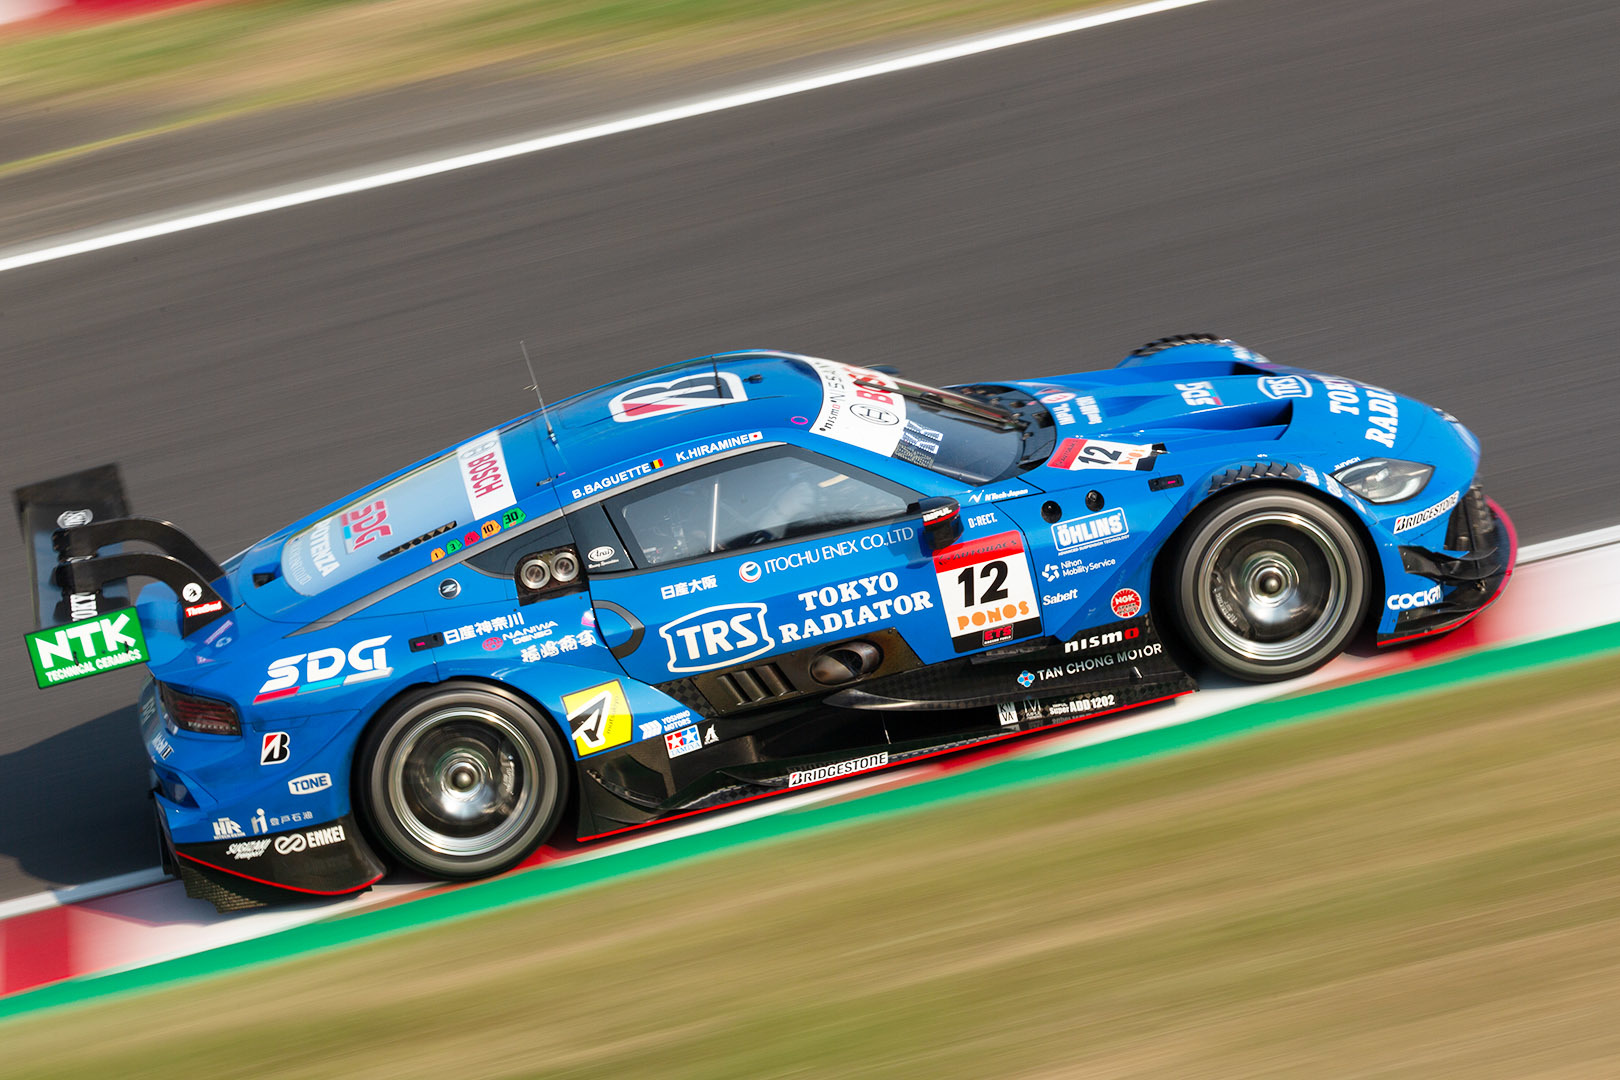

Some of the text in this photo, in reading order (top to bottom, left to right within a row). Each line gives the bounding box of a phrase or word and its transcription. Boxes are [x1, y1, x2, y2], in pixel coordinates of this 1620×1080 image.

[1365, 388, 1398, 448] RADI
[676, 434, 749, 462] K.HIRAMINE
[1078, 446, 1122, 465] 12
[467, 452, 503, 498] BOSCH
[572, 463, 651, 499] B.BAGUETTE
[350, 500, 392, 550] SDG
[504, 511, 519, 524] 30
[1396, 491, 1459, 532] BRIDGESTONE
[483, 524, 494, 534] 10
[1056, 513, 1123, 547] ÖHLINS
[449, 543, 457, 551] 3
[764, 550, 820, 574] ITOCHU
[821, 540, 859, 560] ENEX
[952, 540, 1017, 561] AUTOBACS
[1061, 558, 1082, 569] Nihon
[1089, 558, 1116, 571] Service
[660, 575, 718, 600] 日産大阪
[797, 572, 898, 611] TOKYO
[957, 560, 1008, 608] 12
[1042, 588, 1079, 606] Sabelt
[70, 592, 98, 621] OKY
[778, 590, 933, 644] RADIATOR
[957, 600, 1029, 631] PONOS
[35, 613, 136, 669] NTK
[442, 612, 525, 645] 日産神奈川
[502, 620, 559, 640] NANIWA
[676, 613, 759, 660] TRS
[984, 625, 1012, 641] ETS
[1064, 627, 1140, 654] nismo
[45, 649, 142, 682] TECHNICAL CERAMICS
[259, 635, 392, 693] SDG
[1037, 643, 1163, 681] TAN CHONG MOTOR
[1069, 700, 1091, 714] ADD
[1091, 694, 1116, 709] 1202
[663, 717, 692, 732] MOTORS
[670, 742, 702, 757] TAMIYA
[791, 753, 887, 786] BRIDGESTONE
[291, 776, 328, 793] TONE
[306, 825, 345, 848] ENKEI
